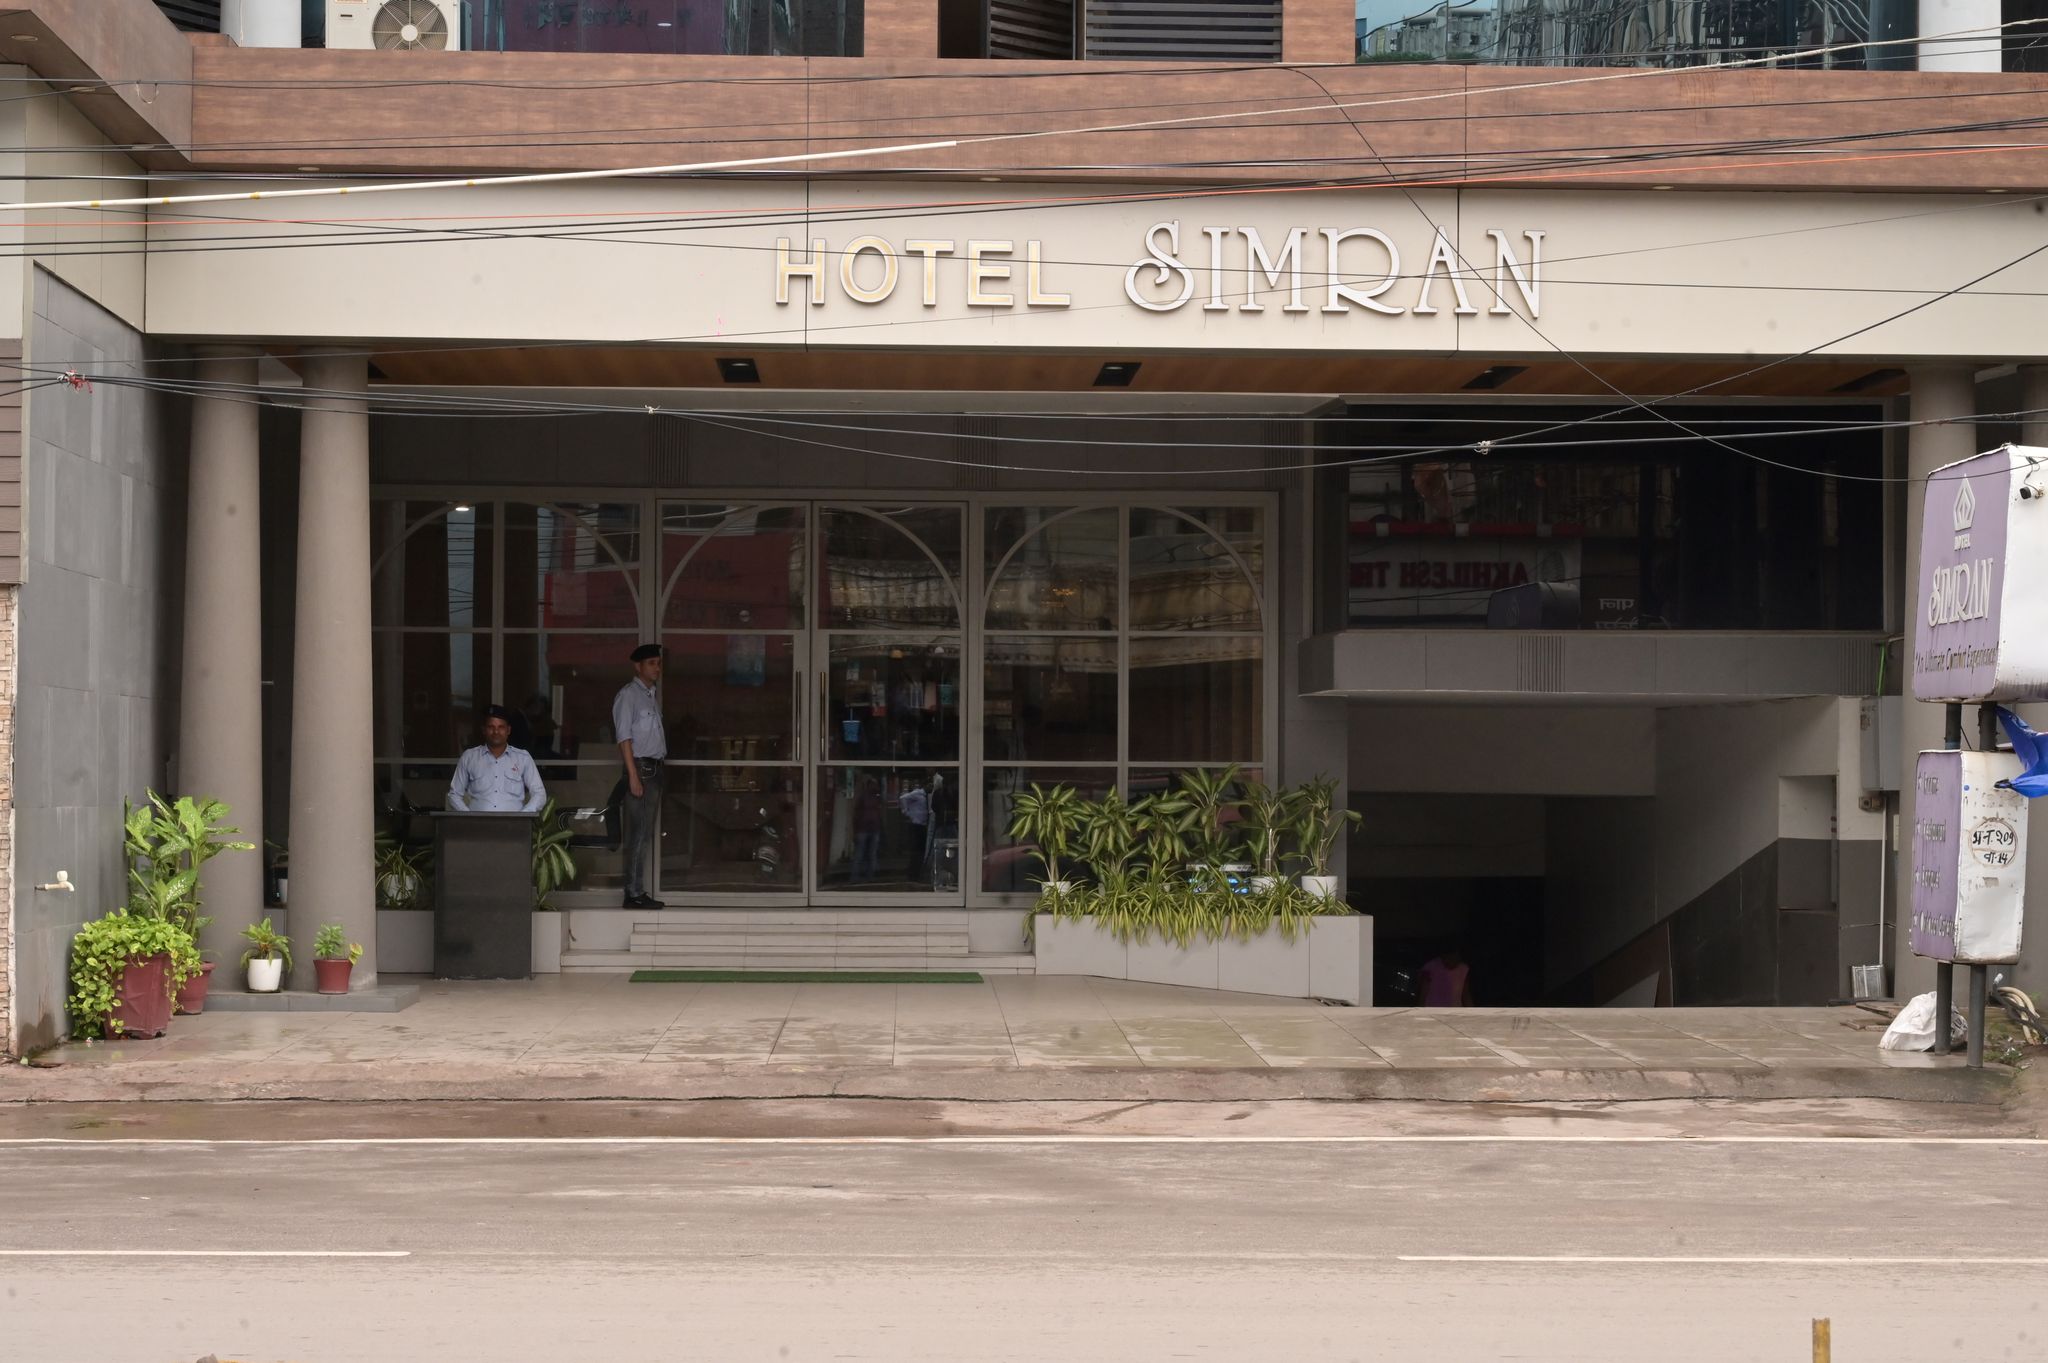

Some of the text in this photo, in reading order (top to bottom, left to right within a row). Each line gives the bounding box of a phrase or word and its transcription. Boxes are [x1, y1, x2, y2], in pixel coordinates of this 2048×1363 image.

[775, 220, 1546, 319] HOTEL SIMRAN
[1954, 533, 1971, 551] HOTEL
[1928, 557, 1994, 628] SIMRAN
